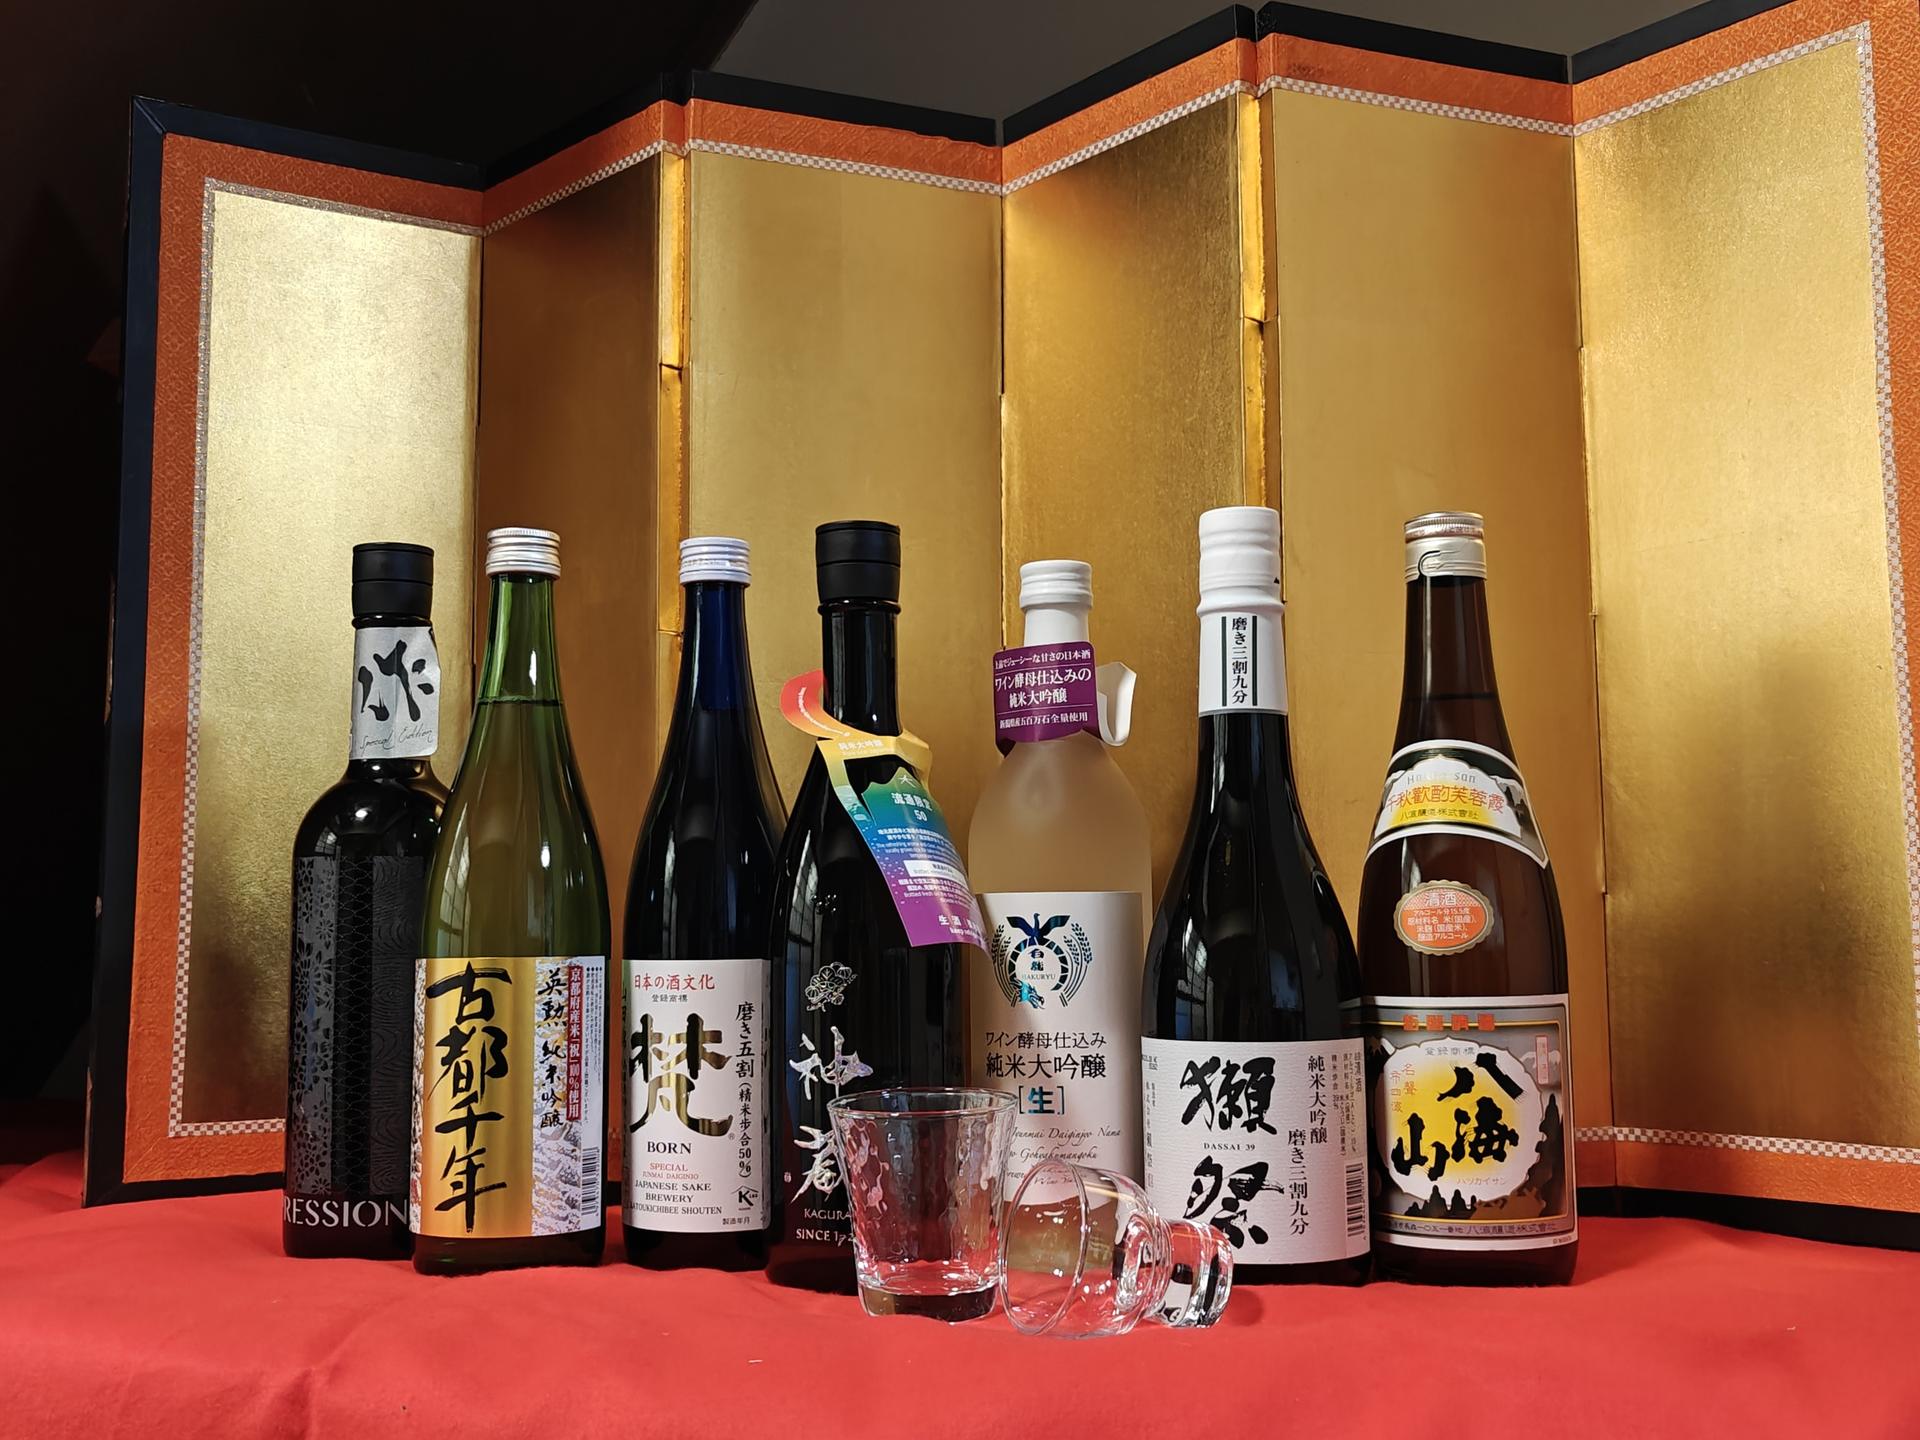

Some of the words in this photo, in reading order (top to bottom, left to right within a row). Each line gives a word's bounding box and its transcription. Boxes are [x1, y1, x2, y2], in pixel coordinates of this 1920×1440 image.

[1232, 616, 1248, 704] 磨き三割九分
[995, 667, 1092, 691] ワイン酵母仕込みの
[1009, 687, 1068, 709] 純米大吟醸
[914, 810, 928, 822] 50
[1424, 892, 1457, 906] 清酒
[634, 973, 716, 992] 日本の酒文化
[986, 1031, 1107, 1050] ワイン酵母仕込み
[630, 1012, 734, 1138] 梵
[986, 1052, 1106, 1080] 純米大吟醸
[426, 960, 513, 1233] 古都千年
[1307, 1055, 1328, 1144] 純米大吟醸
[1391, 1052, 1525, 1182] 八海山
[647, 1141, 693, 1155] BORN
[1203, 1142, 1241, 1150] DASSAI
[1245, 1143, 1256, 1151] 39
[643, 1171, 664, 1179] JUNMAI
[649, 1163, 689, 1172] SPECIAL
[635, 1180, 678, 1191] JAPANESE
[682, 1183, 712, 1191] SAKE
[1288, 1129, 1310, 1235] 磨き三割九分
[645, 1193, 694, 1203] BREWERY
[681, 1206, 723, 1215] SHOUTEN
[796, 1228, 830, 1241] SINCE
